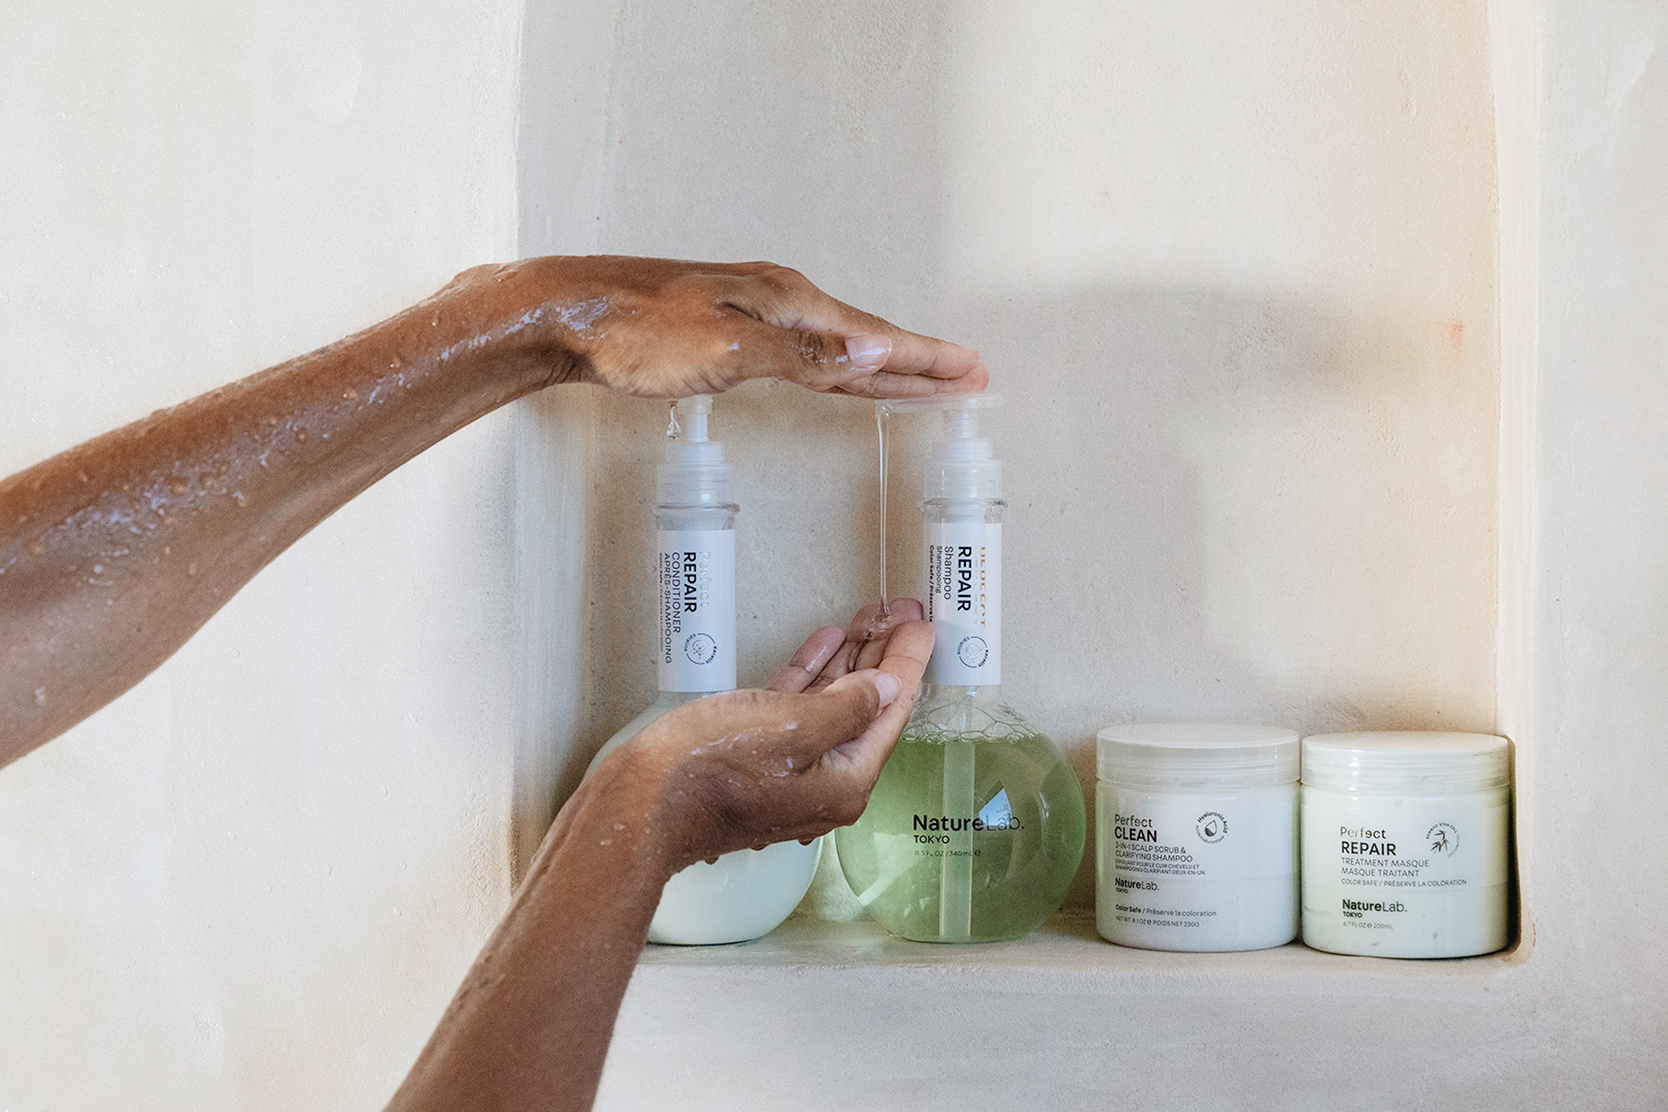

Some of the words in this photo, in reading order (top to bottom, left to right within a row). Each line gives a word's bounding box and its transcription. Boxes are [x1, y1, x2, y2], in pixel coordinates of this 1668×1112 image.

[944, 546, 953, 600] Shampoo
[957, 546, 972, 611] REPAIR
[684, 552, 697, 612] REPAIR
[700, 552, 712, 608] Perfect
[672, 552, 681, 633] CONDITIONER
[913, 813, 1024, 831] NatureLab.
[1115, 814, 1152, 827] Perfect
[1115, 826, 1157, 842] CLEAN
[1340, 826, 1386, 839] Perfect
[914, 835, 950, 844] TOKYO
[1132, 843, 1153, 852] SCALP
[1341, 841, 1396, 856] REPAIR
[1115, 850, 1151, 860] CLARIFYING
[1153, 854, 1193, 862] SHAMPOO
[1341, 857, 1388, 867] TREATMENT
[1391, 860, 1429, 868] MASQUE
[1341, 868, 1375, 877] MASQUE
[1115, 878, 1160, 891] NatureLab.
[1384, 879, 1416, 887] PRÉSERVE
[1146, 908, 1174, 916] Préserve
[1342, 899, 1408, 912] NatureLab.
